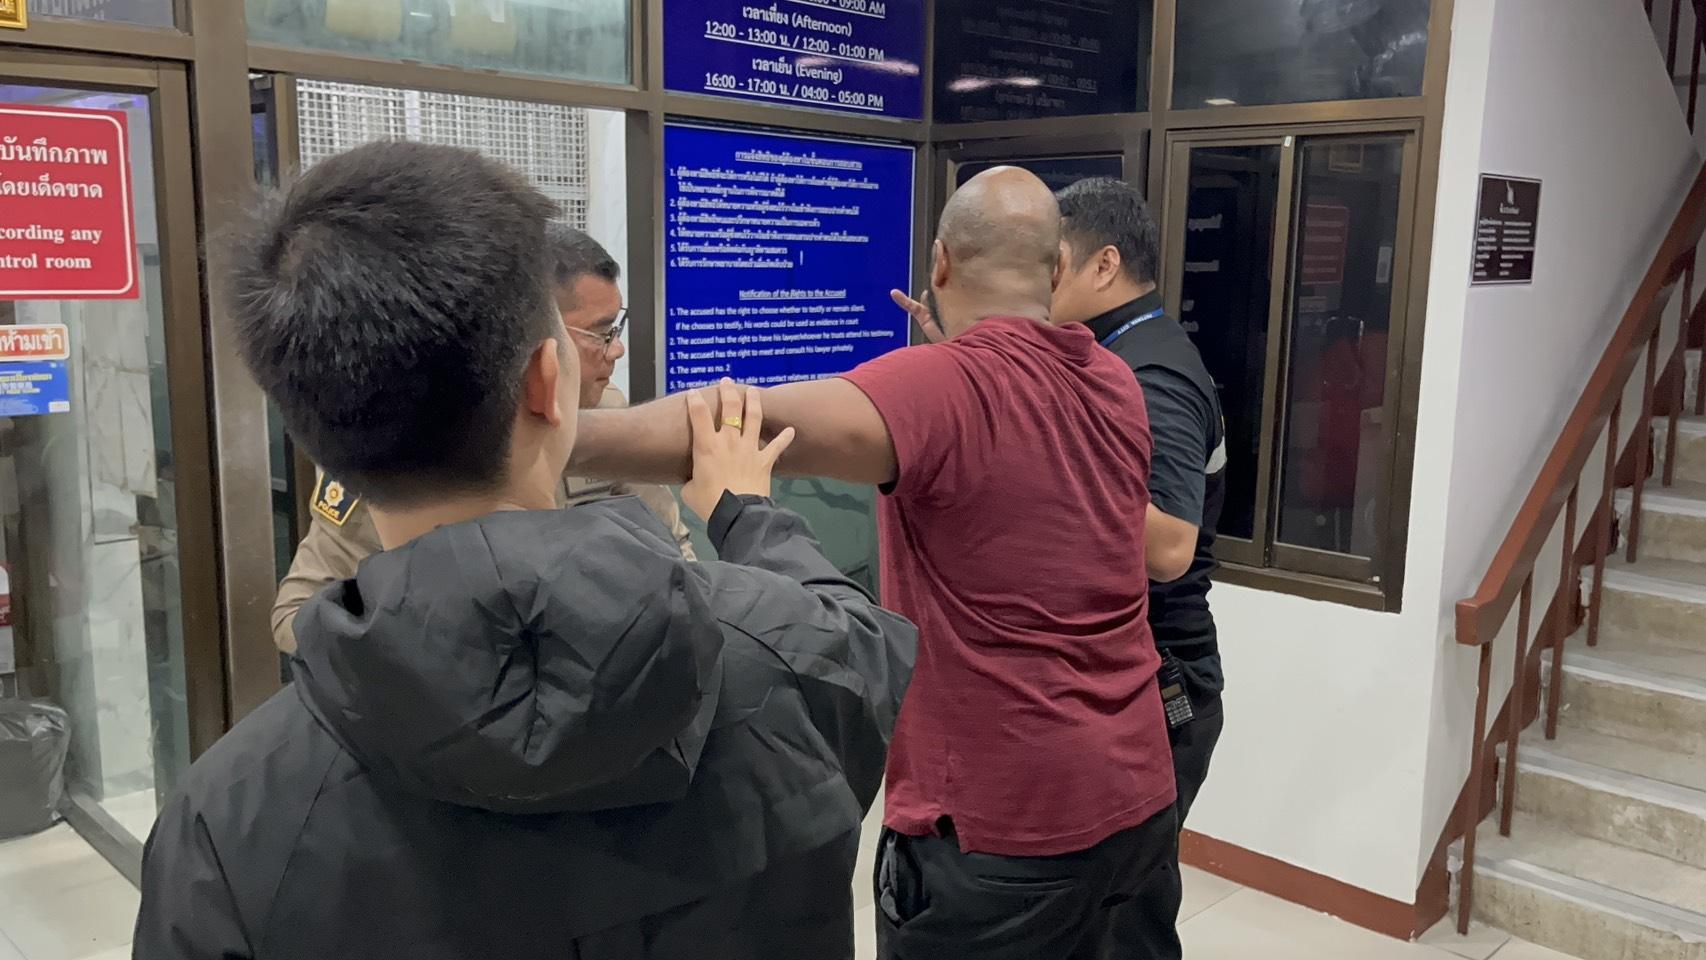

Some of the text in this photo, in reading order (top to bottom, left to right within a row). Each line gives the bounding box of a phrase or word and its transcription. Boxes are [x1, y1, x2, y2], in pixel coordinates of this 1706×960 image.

[840, 0, 866, 12] 09:00
[868, 1, 886, 16] AM
[742, 2, 852, 37] เวลาเที่ยง (Afternoon)
[706, 20, 736, 38] 12:00
[748, 28, 776, 44] 13:00
[802, 37, 829, 52] 12:00
[838, 43, 866, 58] 01:00
[868, 48, 884, 62] PM
[752, 56, 842, 84] เวลาเย็น (Evening)
[706, 72, 736, 88] 16:00
[748, 78, 776, 94] 17:00
[801, 86, 828, 100] 04:00
[838, 90, 865, 106] 05:00
[868, 94, 884, 107] PM
[0, 225, 102, 244] cording any
[45, 256, 92, 268] room
[739, 290, 771, 299] Notification
[773, 289, 779, 298] of
[780, 290, 789, 298] the
[815, 289, 824, 298] the
[825, 288, 846, 298] Accused
[677, 308, 688, 316] The
[690, 308, 714, 316] accused
[738, 307, 750, 316] right
[809, 305, 824, 314] testify
[738, 335, 750, 344] right
[690, 351, 715, 359] accused
[738, 349, 750, 358] right
[815, 345, 831, 354] lawyer
[318, 500, 340, 519] POLICE
